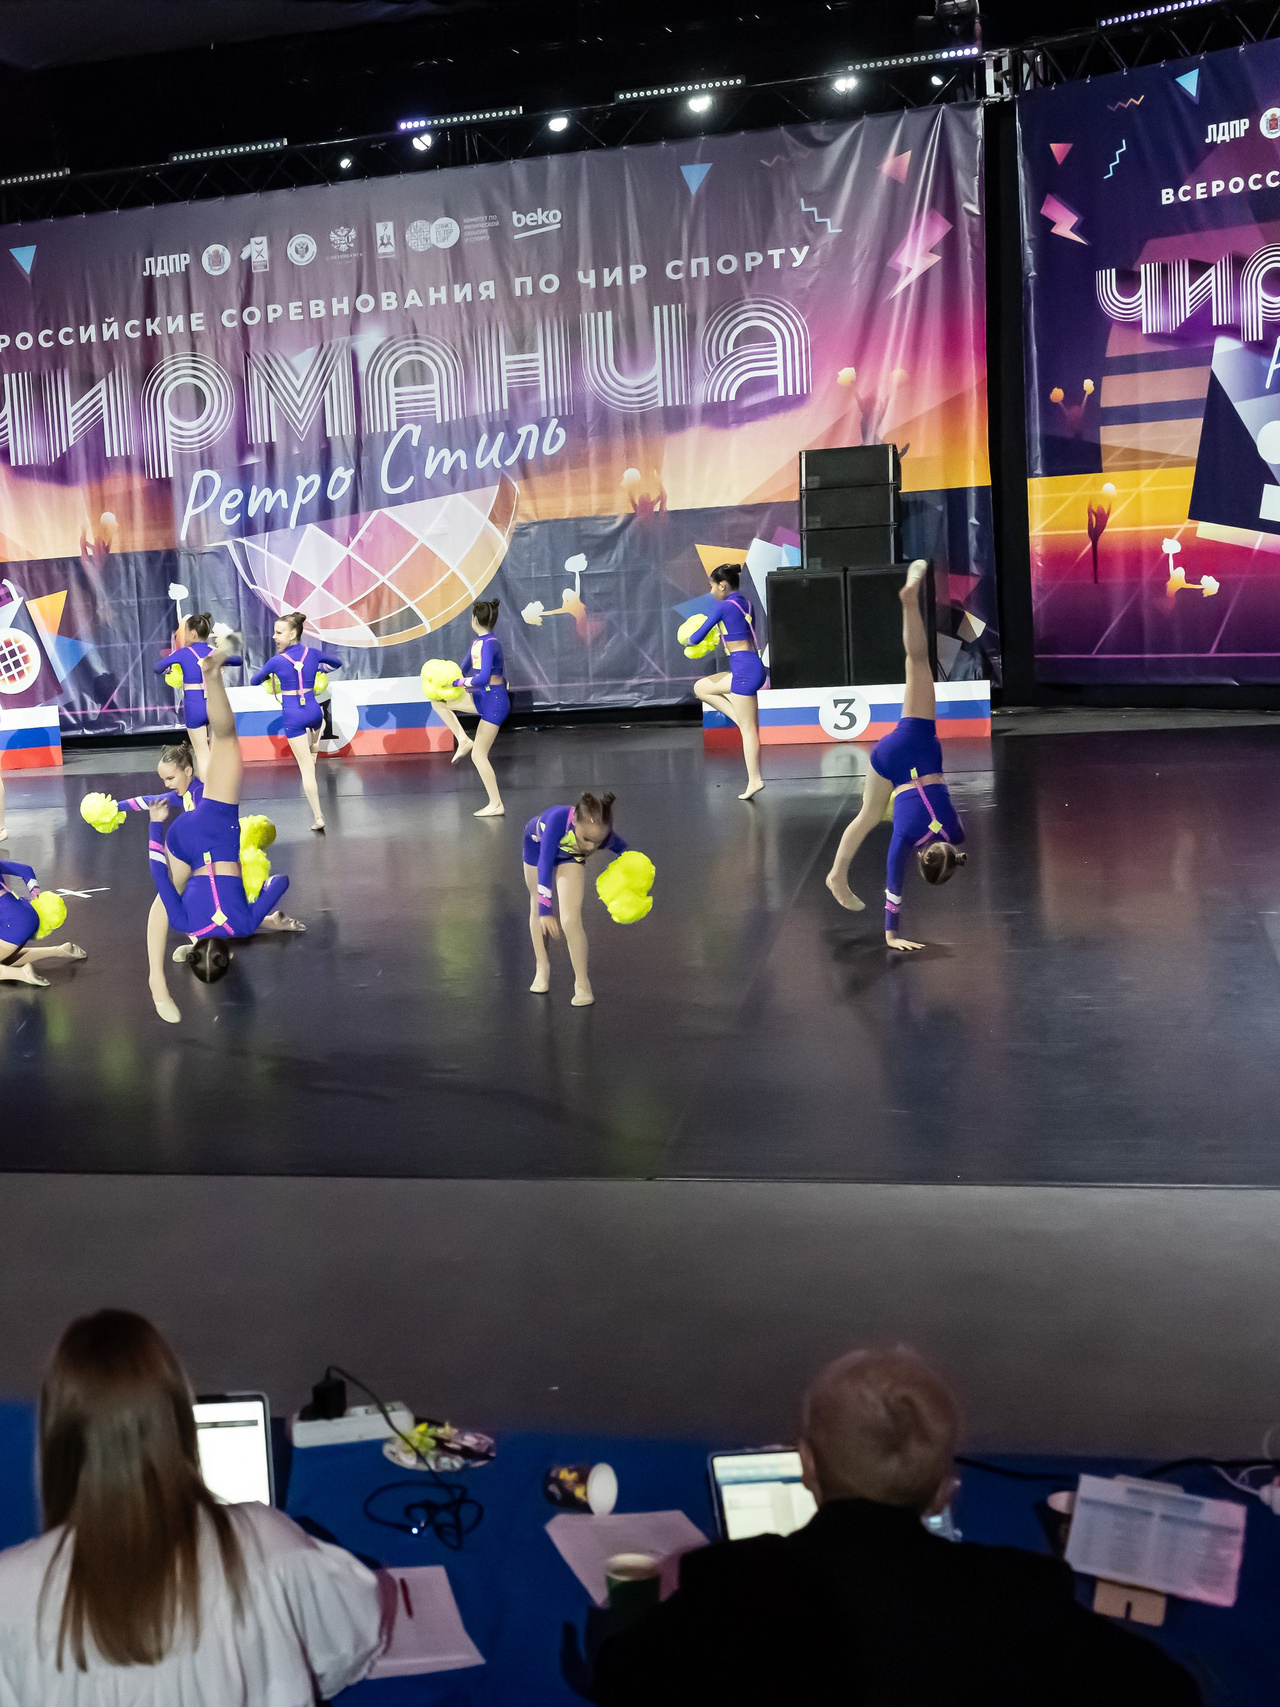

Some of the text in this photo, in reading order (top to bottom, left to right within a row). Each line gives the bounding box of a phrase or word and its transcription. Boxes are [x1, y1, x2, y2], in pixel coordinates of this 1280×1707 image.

[1205, 118, 1250, 144] ЛДПР
[512, 208, 562, 228] beko
[143, 253, 190, 277] ЛДПР
[221, 280, 495, 328] СОРЕВНОВАНИЯ
[514, 273, 560, 297] ПО
[577, 264, 647, 289] ЧИР
[665, 245, 810, 280] СПОРТУ
[180, 418, 567, 541] Ретро Стиль
[832, 698, 857, 730] 3
